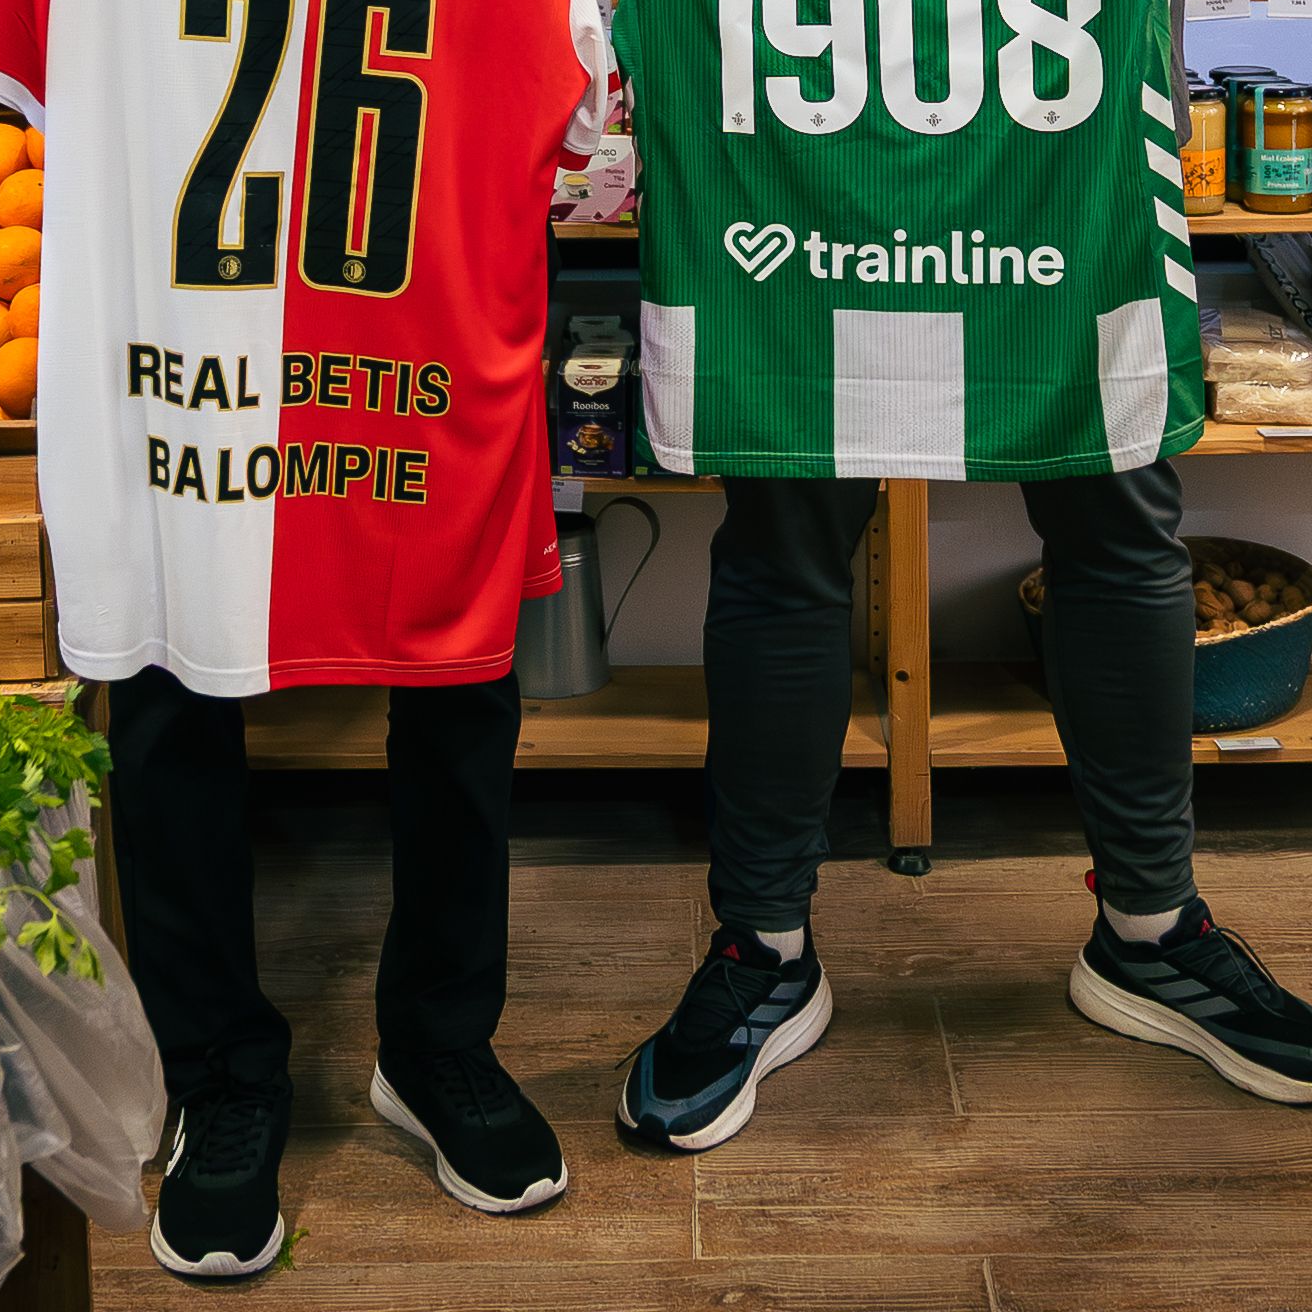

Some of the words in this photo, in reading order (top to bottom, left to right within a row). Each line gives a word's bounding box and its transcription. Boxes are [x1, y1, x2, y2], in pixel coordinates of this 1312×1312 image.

[802, 228, 1065, 286] trainline
[126, 341, 261, 412] REAL
[279, 351, 452, 417] BETIS
[573, 401, 610, 410] Rooibos
[146, 434, 429, 505] BALOMPIE
